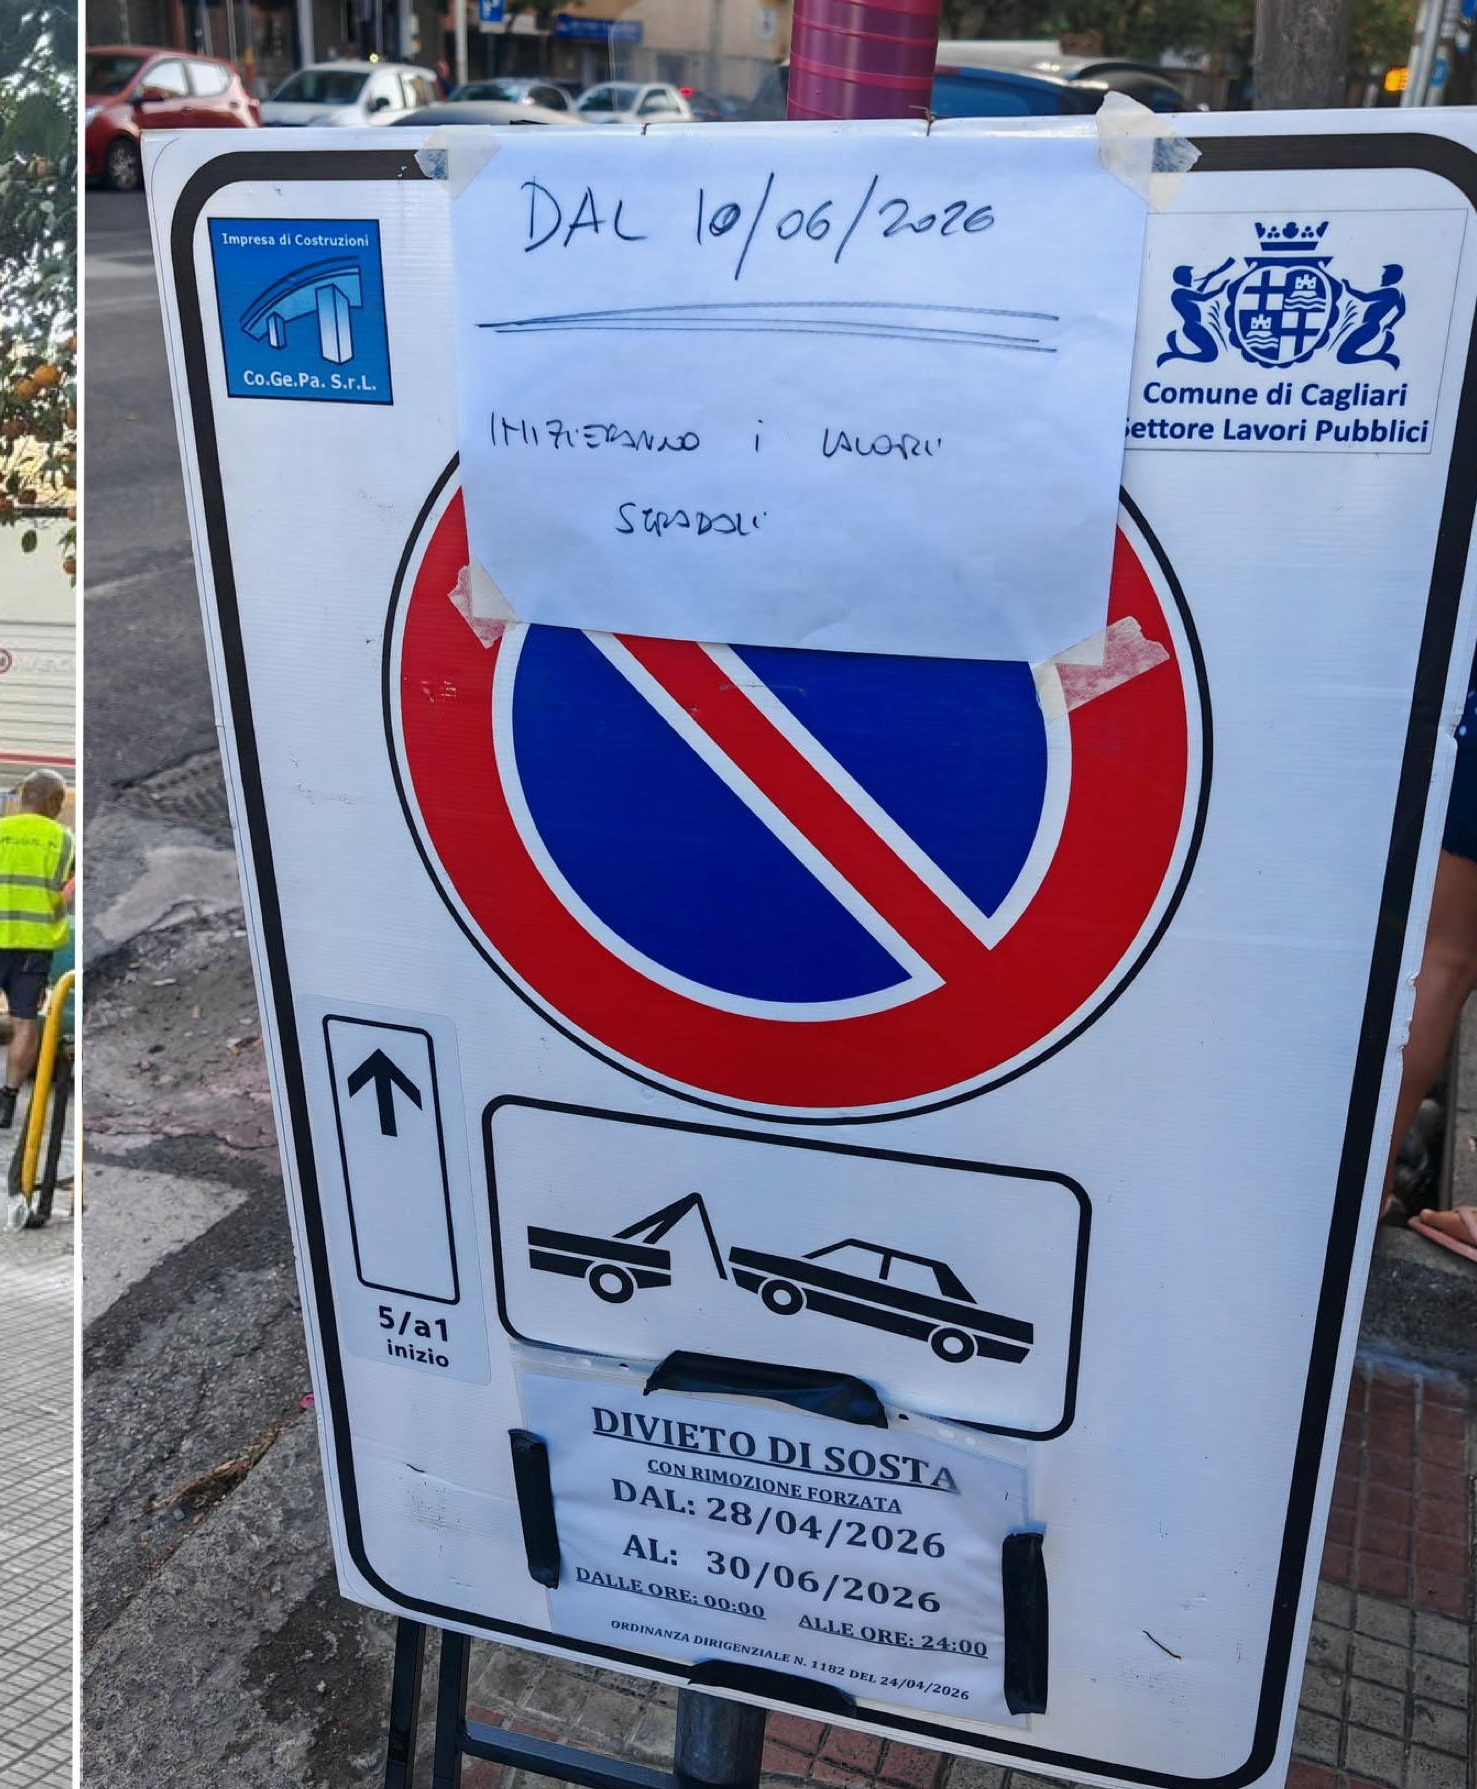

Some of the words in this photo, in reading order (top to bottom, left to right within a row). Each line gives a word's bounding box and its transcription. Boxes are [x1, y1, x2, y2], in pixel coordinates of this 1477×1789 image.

[222, 233, 275, 247] Impresa
[279, 233, 292, 246] di
[295, 234, 369, 248] Costruzioni
[521, 176, 648, 252] DAL
[699, 172, 994, 280] 10/06/2026
[244, 370, 325, 388] Co.Ge.Pa.
[331, 373, 377, 391] S.r.L.
[1143, 382, 1258, 405] Comune
[1266, 382, 1292, 405] di
[1301, 383, 1408, 411] Cagliari
[1224, 418, 1307, 441] Lavori
[1315, 419, 1429, 443] Pubblici
[379, 1304, 448, 1342] 5/a1
[387, 1338, 449, 1368] inizio
[592, 1407, 756, 1457] DIVIETO
[768, 1435, 812, 1469] DI
[825, 1446, 959, 1492] SOSTA
[647, 1459, 686, 1478] CON
[692, 1467, 802, 1499] RIMOZIONE
[808, 1486, 902, 1514] FORZATA
[611, 1478, 695, 1516] DAL:
[707, 1497, 946, 1559] 28/04/2026
[575, 1566, 643, 1593] DALLE
[648, 1583, 699, 1605] ORE:
[703, 1595, 765, 1618] 00:00
[623, 1534, 678, 1566] AL:
[707, 1550, 941, 1613] 30/06/2026
[798, 1614, 854, 1637] ALLE
[860, 1626, 914, 1647] ORE:
[921, 1635, 989, 1656] 24:00
[611, 1620, 690, 1643] ORDINANZA
[693, 1635, 790, 1663] DIRIGENZIALE
[793, 1655, 807, 1668] N.
[811, 1660, 845, 1676] 1182
[849, 1669, 876, 1684] DEL
[880, 1676, 970, 1700] 24/04/2026
